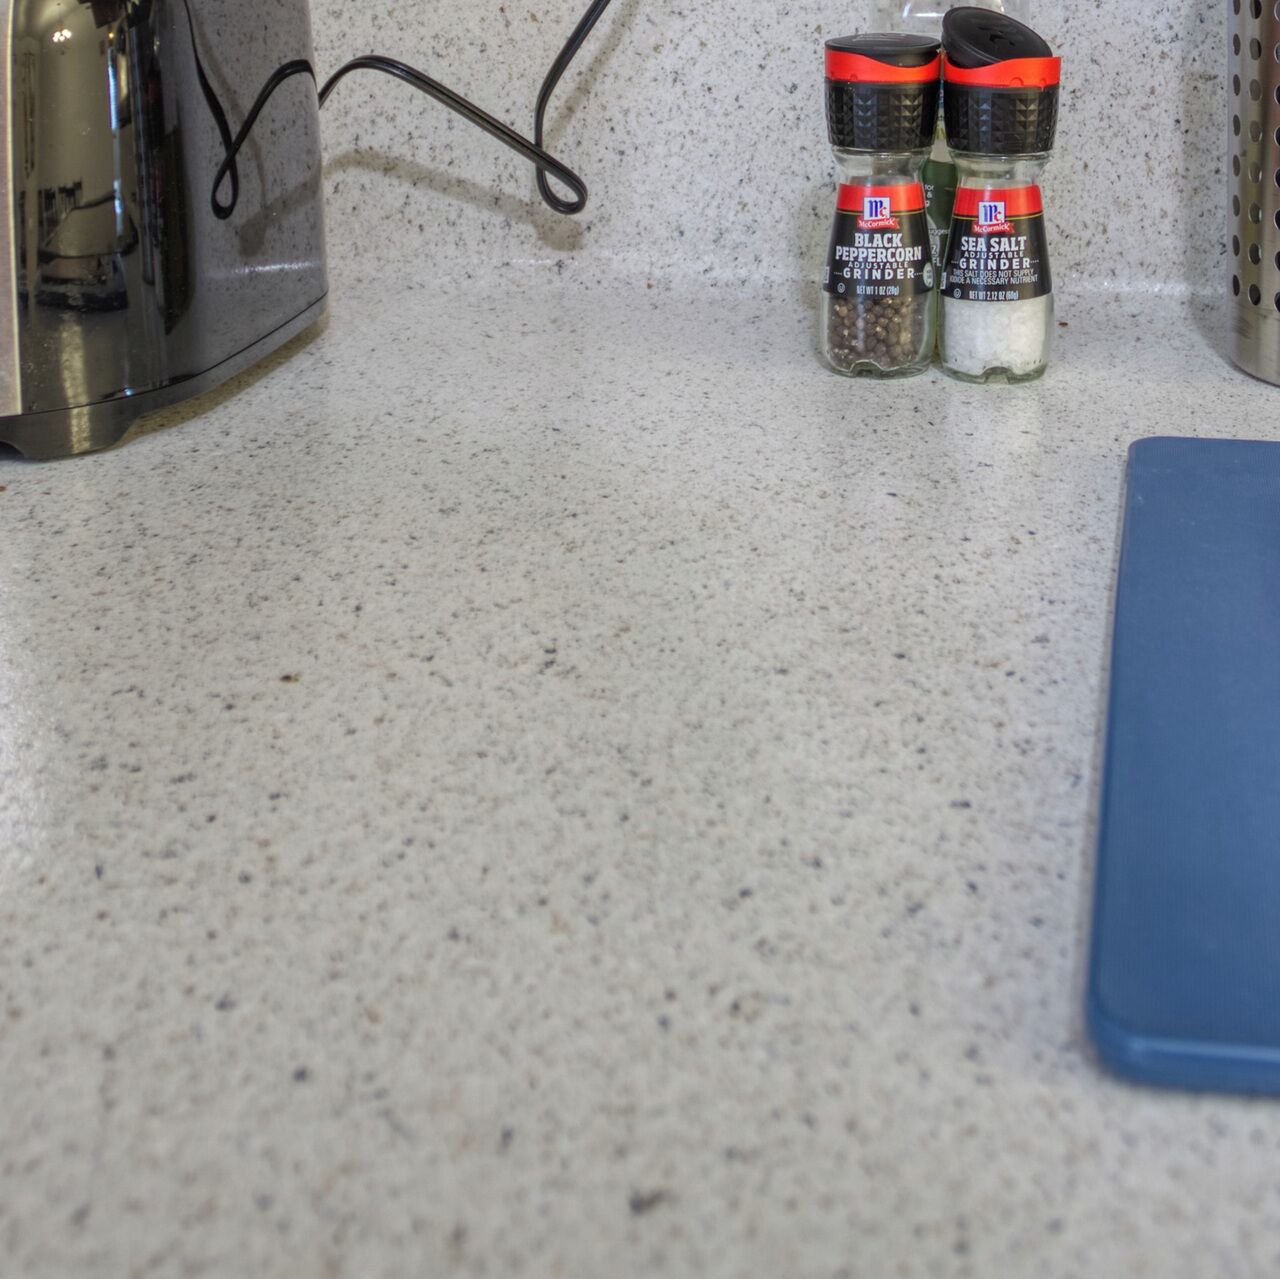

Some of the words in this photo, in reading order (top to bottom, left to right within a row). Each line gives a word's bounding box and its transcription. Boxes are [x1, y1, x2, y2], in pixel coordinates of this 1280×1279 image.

[858, 217, 895, 228] McCormick
[974, 223, 1010, 233] McCormick
[854, 233, 903, 247] BLACK
[961, 236, 987, 252] SEA
[990, 236, 1027, 252] SALT
[835, 246, 922, 262] PEPPERCORN
[964, 251, 1024, 259] ADJUSTABLE
[848, 261, 909, 269] ADJUSTABLE
[959, 257, 1030, 270] GRINDER
[843, 267, 915, 280] GRINDER
[980, 270, 997, 278] DOES
[998, 270, 1012, 278] NOT
[1013, 268, 1034, 277] SUPPLY
[971, 277, 1009, 285] NECESSARY
[1010, 274, 1038, 284] NUTRIENT
